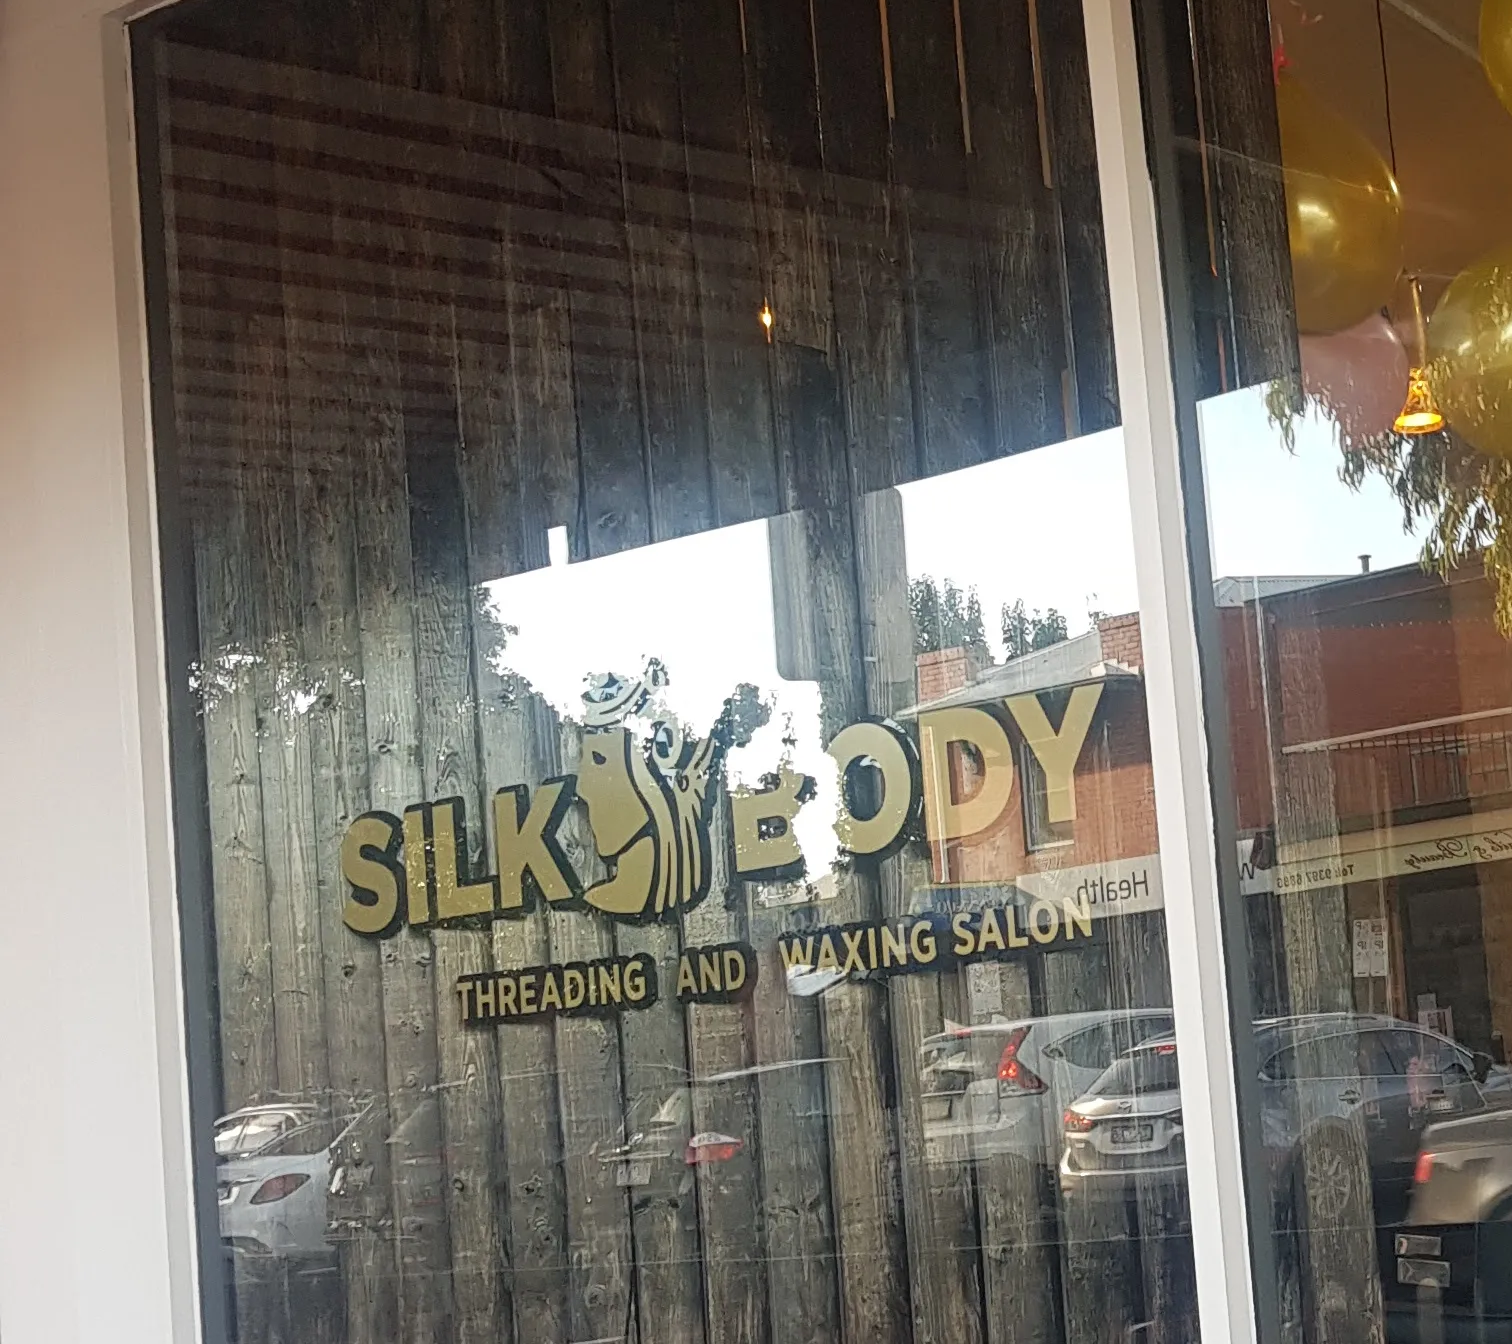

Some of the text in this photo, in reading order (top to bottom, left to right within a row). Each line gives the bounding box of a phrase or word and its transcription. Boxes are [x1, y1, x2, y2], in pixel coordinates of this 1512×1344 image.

[341, 683, 1104, 935] SILK BODY
[456, 960, 647, 1020] THREADING
[676, 949, 747, 996] AND
[778, 920, 938, 975] WAXING
[952, 892, 1094, 956] SALON
